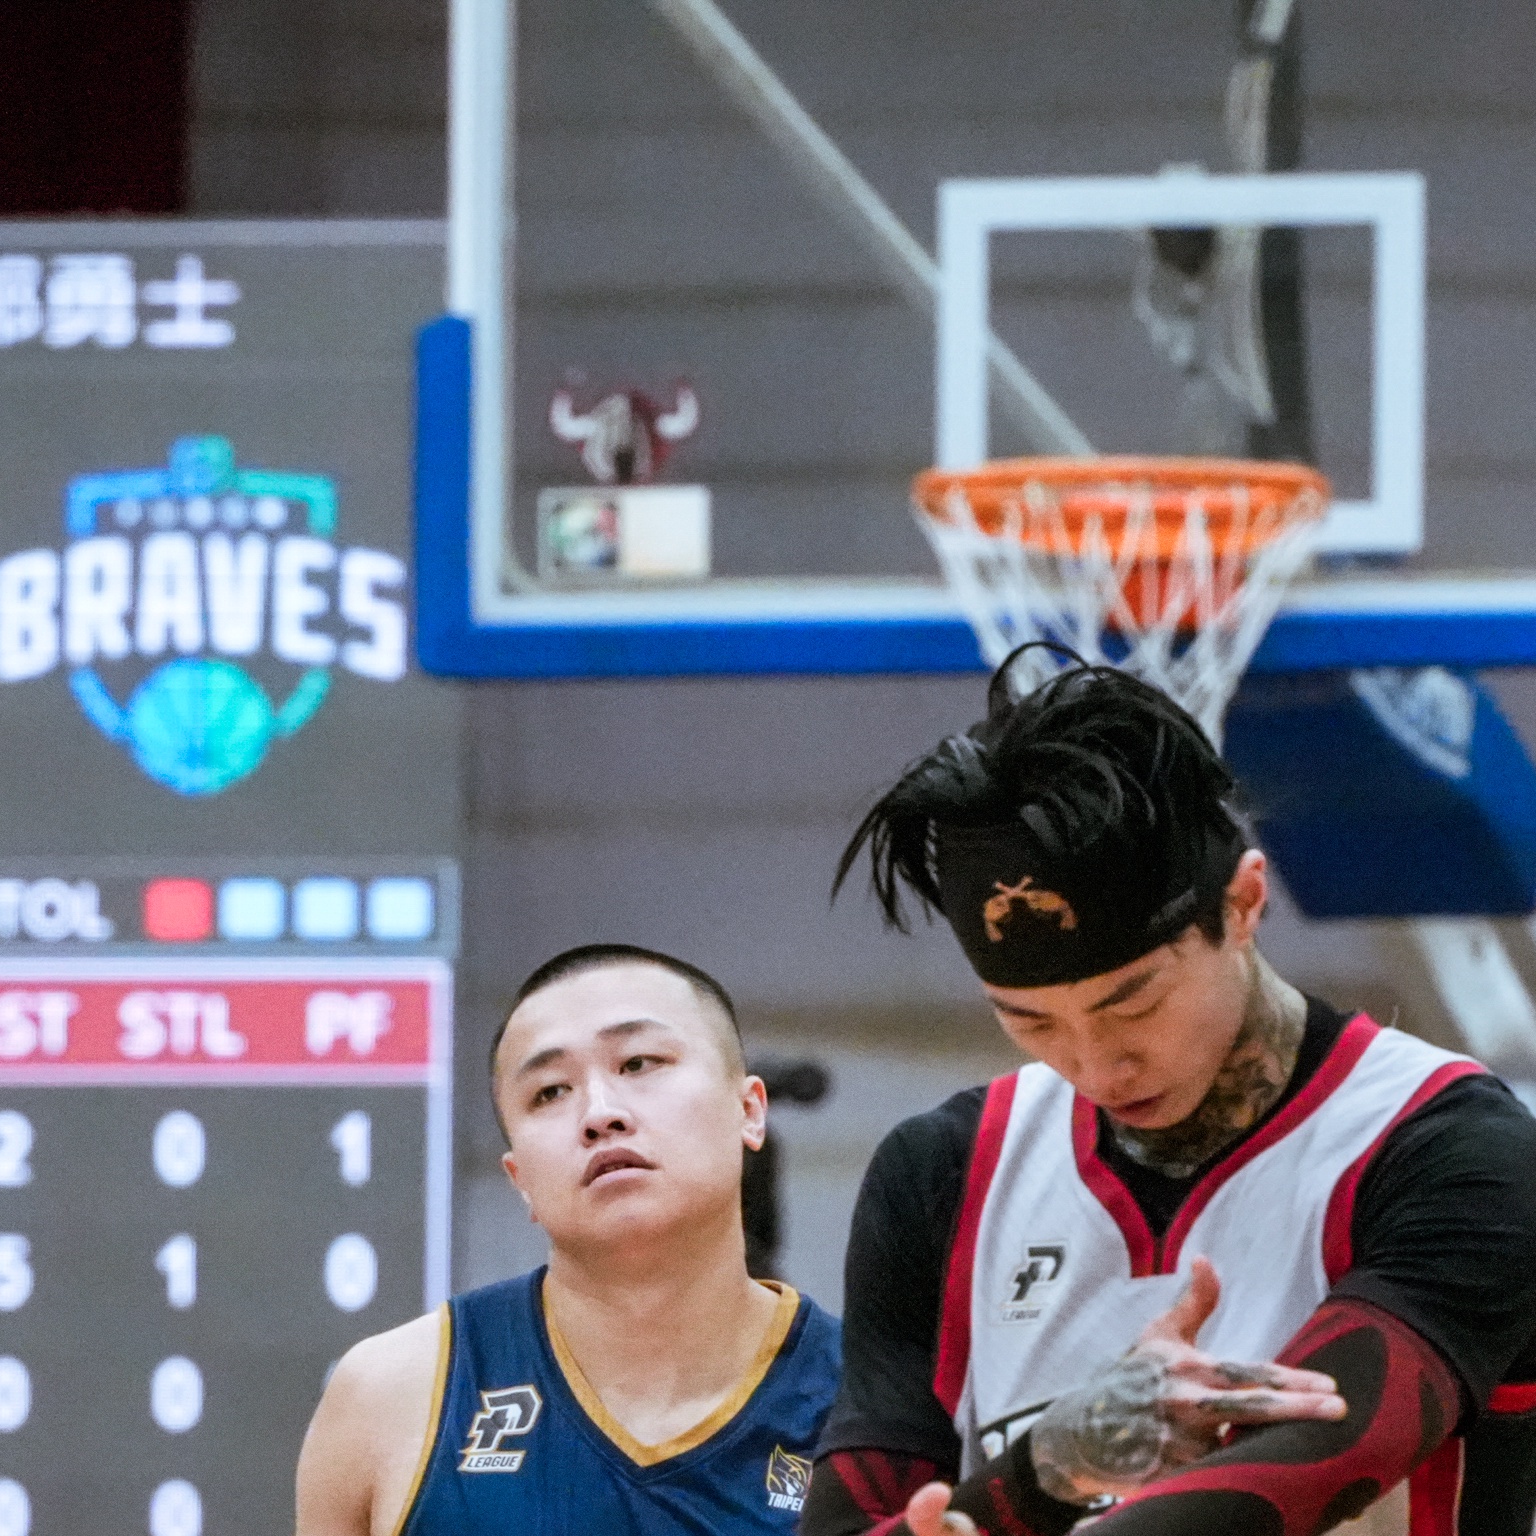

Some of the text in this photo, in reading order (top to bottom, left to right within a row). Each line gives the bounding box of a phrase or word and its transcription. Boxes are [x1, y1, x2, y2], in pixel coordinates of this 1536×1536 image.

[114, 987, 250, 1062] STL
[302, 987, 394, 1059] PF
[149, 1107, 209, 1192] 0
[327, 1107, 374, 1190] 1
[152, 1231, 199, 1311] 1
[321, 1230, 381, 1315] 0
[147, 1352, 207, 1437] 0
[467, 1456, 519, 1468] LEAGUE
[767, 1491, 805, 1512] TAIPEI
